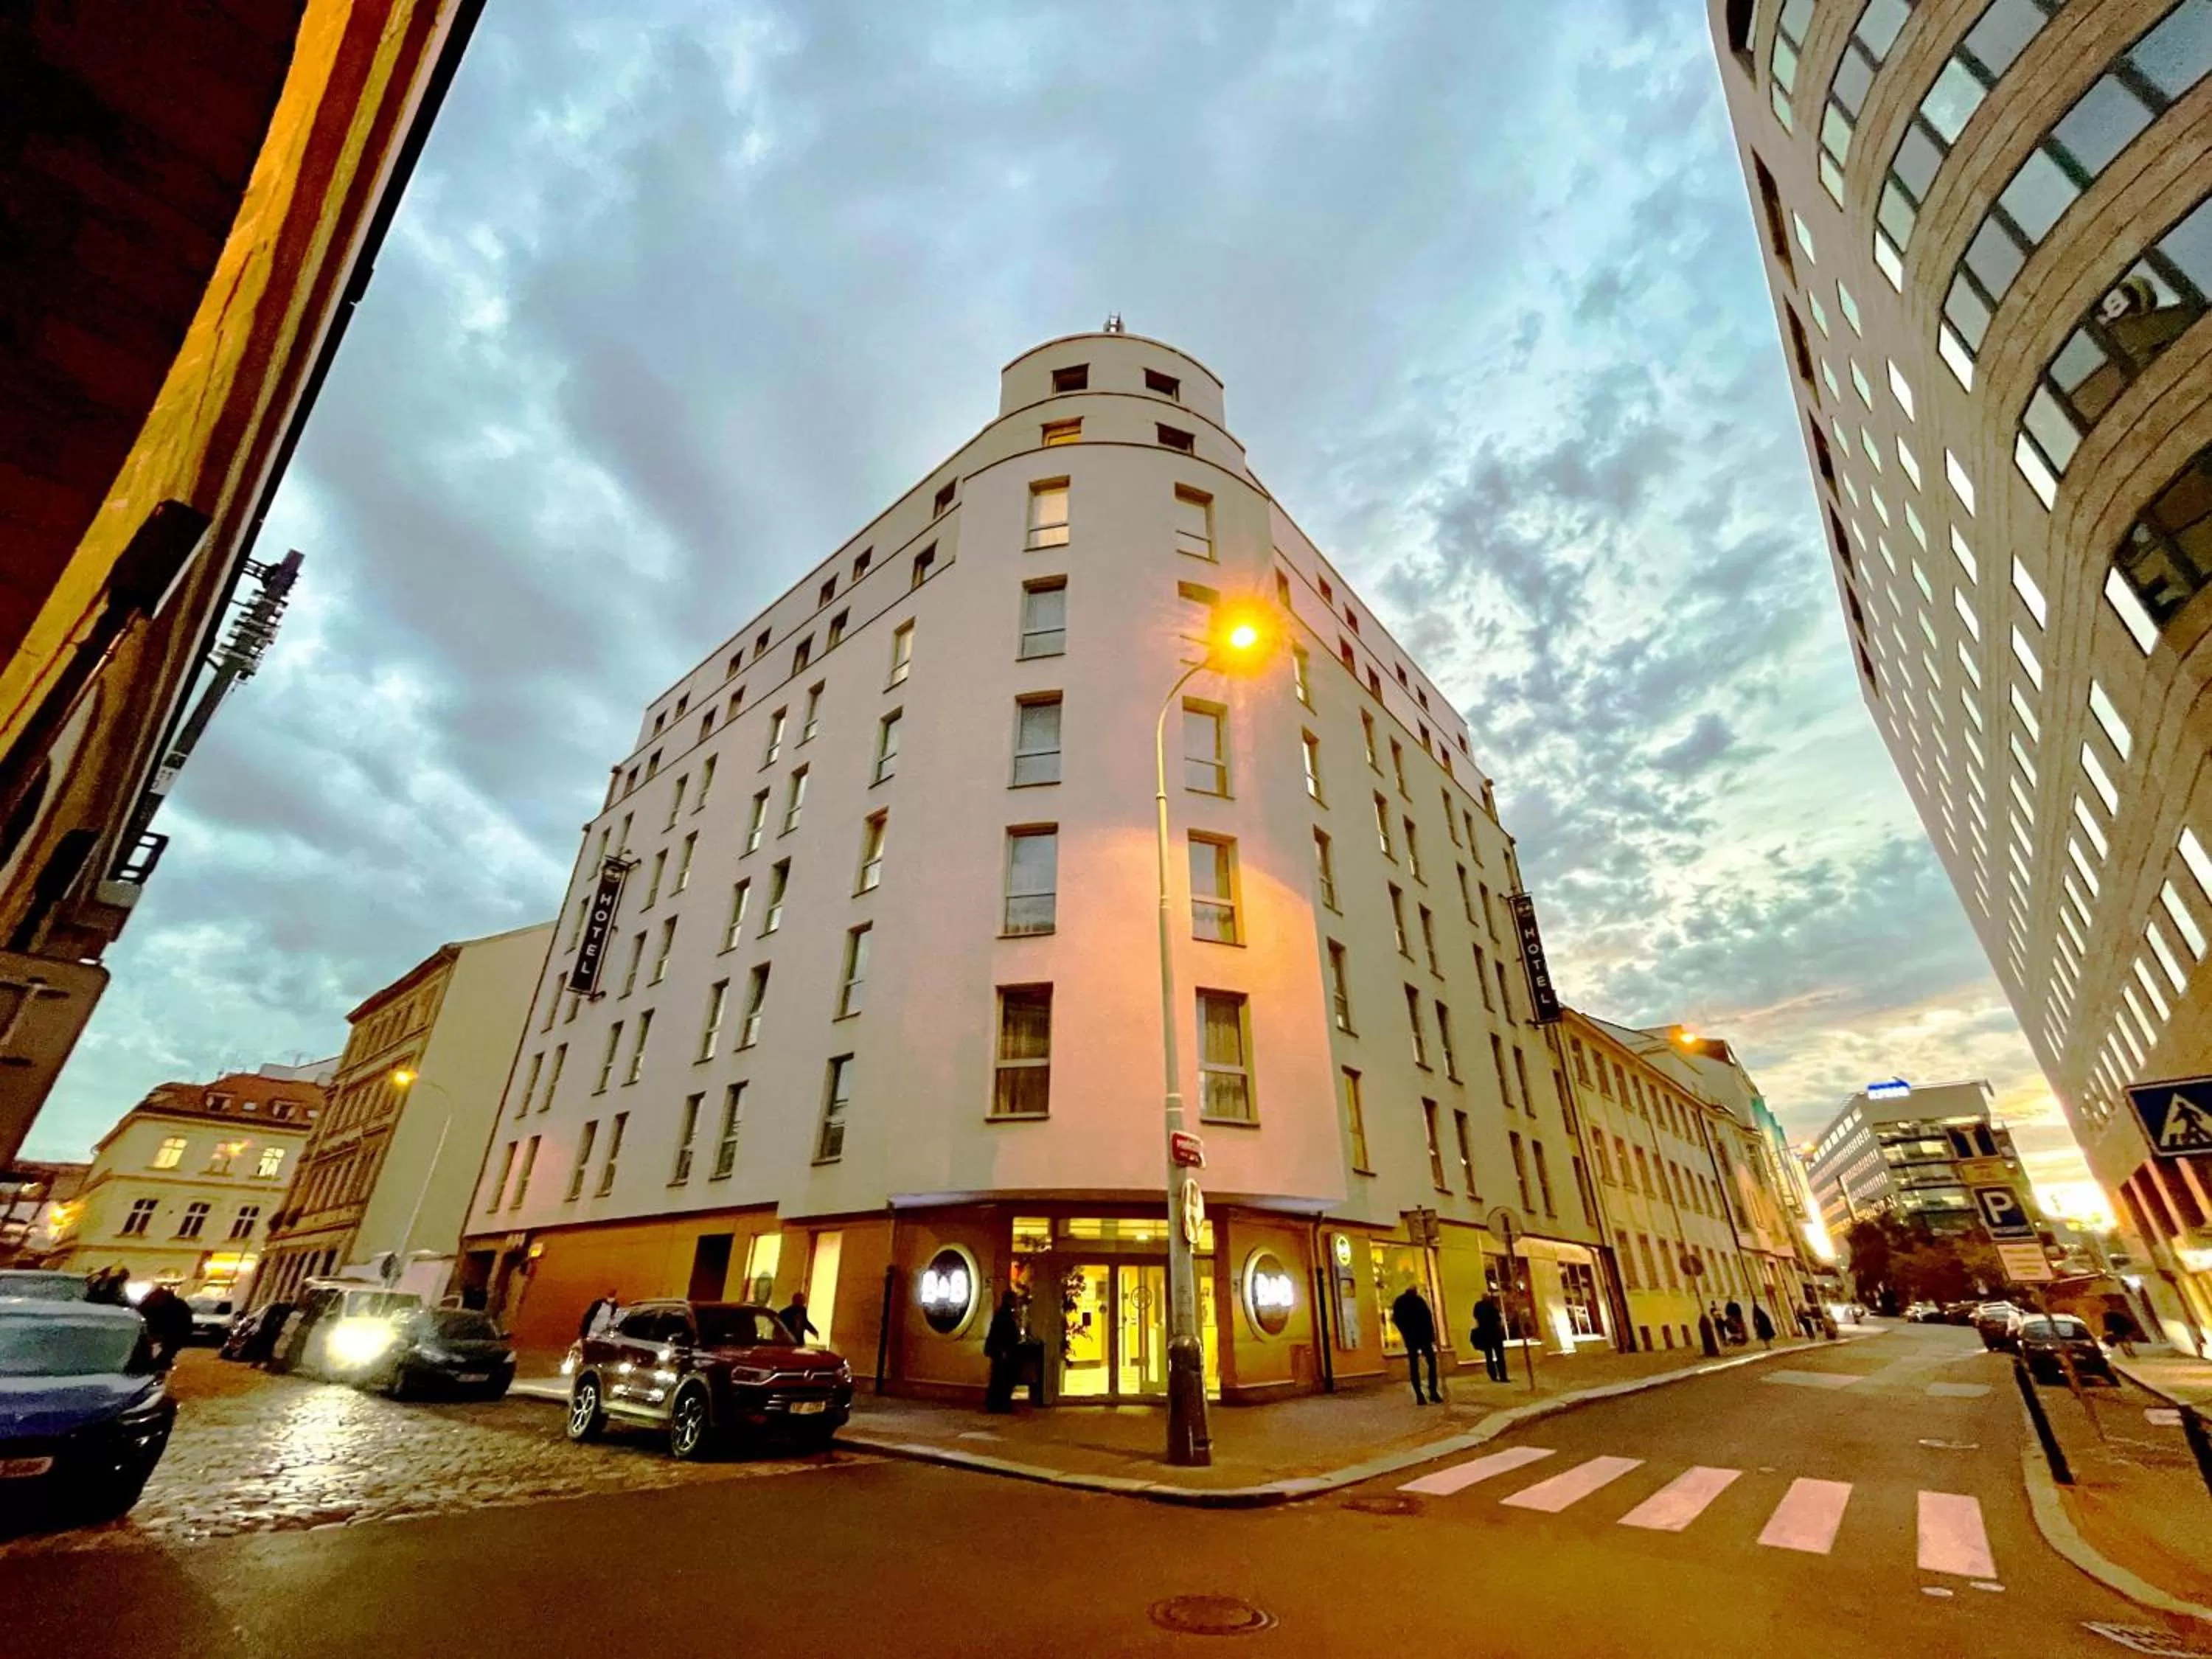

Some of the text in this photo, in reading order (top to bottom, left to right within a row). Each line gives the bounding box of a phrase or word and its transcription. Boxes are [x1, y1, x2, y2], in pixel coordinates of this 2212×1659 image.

[581, 893, 611, 974] HOTEL
[1524, 927, 1551, 1004] HOTEL
[1982, 1191, 2014, 1224] P
